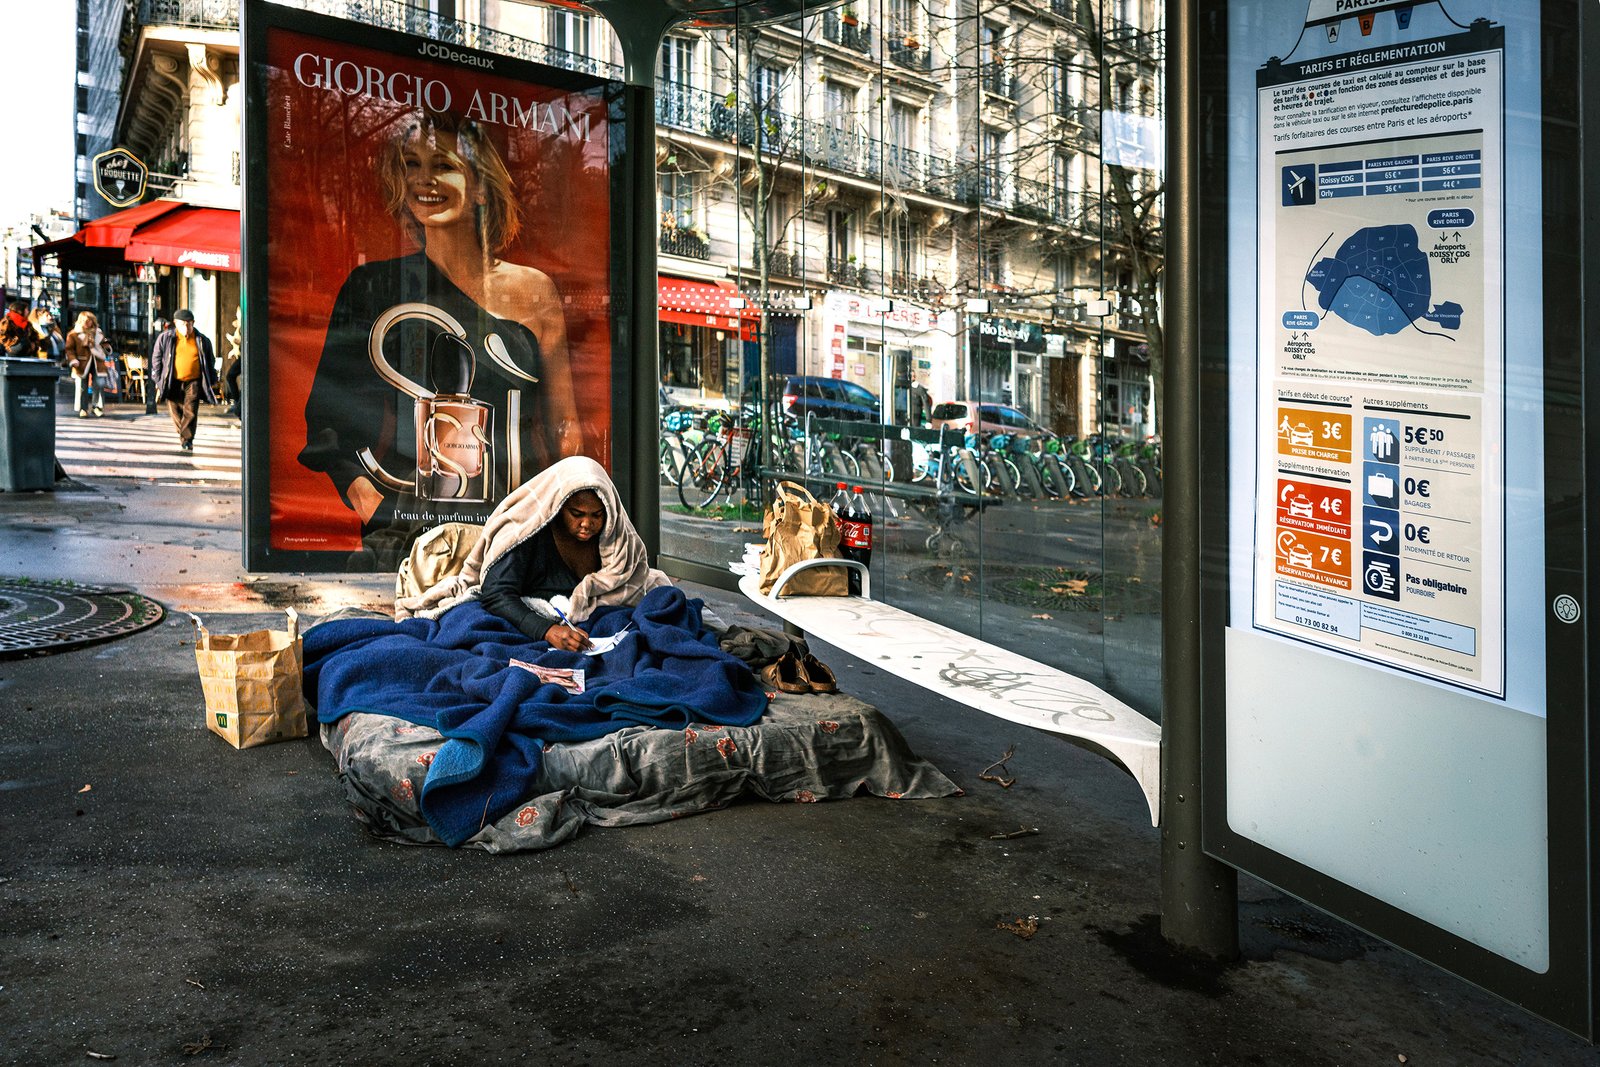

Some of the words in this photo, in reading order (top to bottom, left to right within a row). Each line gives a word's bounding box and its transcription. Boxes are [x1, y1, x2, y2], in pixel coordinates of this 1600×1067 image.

[1363, 20, 1370, 30] B
[1400, 13, 1407, 23] C
[1330, 28, 1336, 37] A
[418, 41, 495, 70] JCDecaux
[1300, 62, 1333, 75] TARIFS
[1336, 58, 1347, 68] ET
[1350, 42, 1446, 68] RÉGLEMENTATION
[1308, 83, 1331, 91] courses
[1343, 77, 1354, 85] taxi
[1369, 72, 1393, 83] calculé
[1406, 66, 1440, 76] compteur
[1458, 60, 1464, 68] la
[1468, 58, 1486, 66] base
[1338, 84, 1364, 94] fonction
[1378, 80, 1398, 88] zones
[1400, 74, 1437, 84] desservies
[1451, 69, 1464, 77] des
[1466, 67, 1486, 77] jours
[293, 52, 452, 113] GIORGIO
[464, 88, 592, 143] ARMANI
[1281, 102, 1303, 110] heures
[1314, 97, 1334, 106] trajet.
[1287, 110, 1311, 120] connaître
[1318, 106, 1347, 115] tarification
[1357, 101, 1380, 110] vigueur,
[1382, 97, 1410, 107] consultez
[1412, 93, 1445, 102] l'affichette
[1448, 87, 1482, 98] disponible
[1292, 117, 1312, 126] véhicule
[1358, 109, 1379, 117] internet
[1381, 97, 1473, 115] prefecturedepolice.paris
[1291, 129, 1325, 140] forfaitaires
[1340, 125, 1365, 133] courses
[1367, 124, 1385, 132] entre
[1388, 119, 1405, 128] Paris
[1320, 177, 1340, 185] Roissy
[1278, 389, 1293, 397] Tarifs
[1362, 397, 1383, 408] Autres
[1385, 400, 1428, 410] suppléments
[1322, 421, 1342, 440] 3€
[1316, 451, 1339, 459] CHARGE
[1404, 446, 1441, 455] SUPPLÉMENT
[1446, 451, 1475, 459] PASSAGER
[1278, 460, 1314, 472] Suppléments
[1315, 466, 1350, 477] réservation
[1450, 461, 1475, 469] PERSONNE
[1404, 477, 1430, 498] 0€
[1320, 497, 1342, 516] 4€
[1404, 500, 1431, 509] BAGAGES
[394, 510, 419, 520] l'eau
[422, 511, 434, 520] de
[438, 512, 473, 523] parfum
[1280, 516, 1314, 528] RÉSERVATION
[1316, 523, 1347, 535] IMMÉDIATE
[1404, 523, 1430, 544] 0€
[1320, 546, 1342, 566] 7€
[1404, 545, 1436, 556] INDEMNITÉ
[1446, 554, 1470, 563] RETOUR
[1278, 565, 1315, 579] RÉSERVATION
[1321, 576, 1348, 587] L'AVANCE
[1406, 574, 1420, 584] Pas
[1422, 579, 1467, 595] obligatoire
[1406, 586, 1436, 598] POURBOIRE
[1304, 618, 1311, 626] 73
[1313, 620, 1320, 628] 00
[1322, 622, 1328, 630] 82
